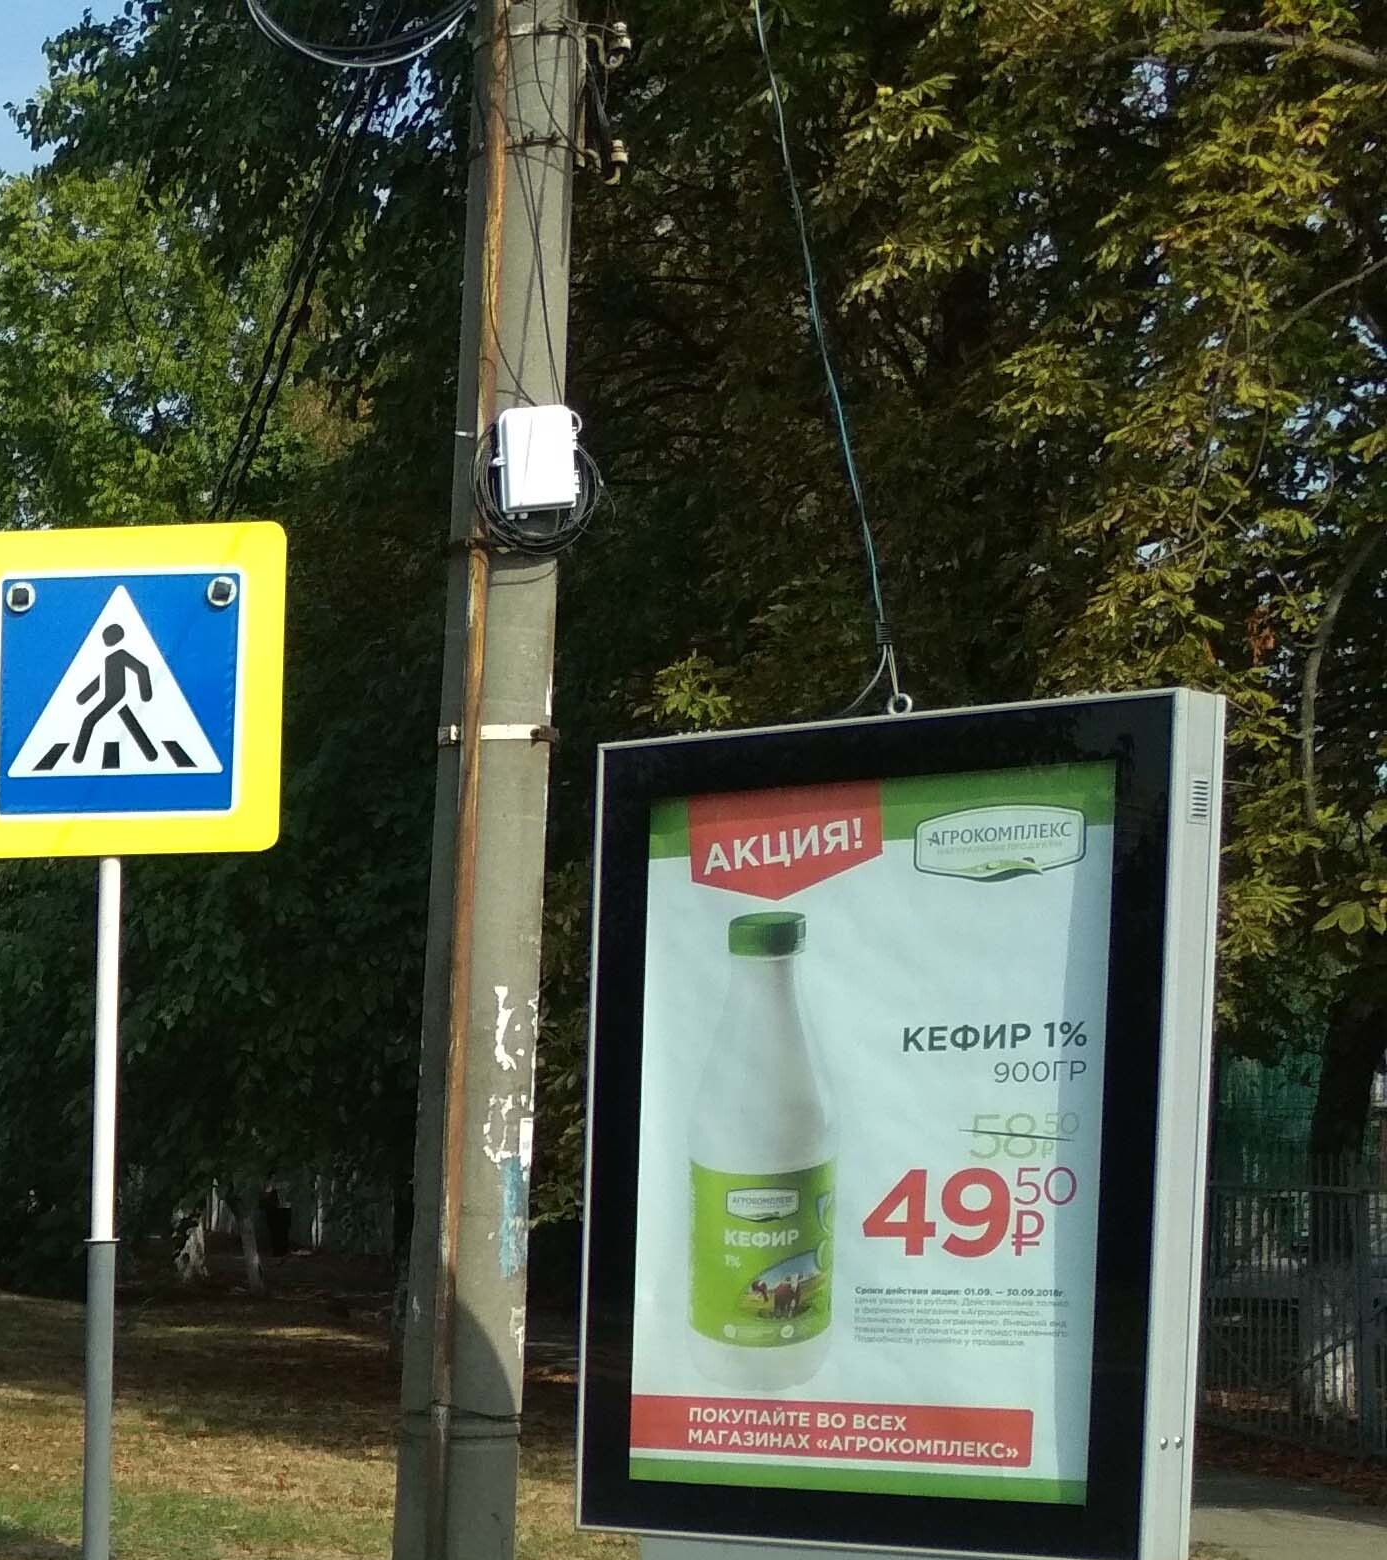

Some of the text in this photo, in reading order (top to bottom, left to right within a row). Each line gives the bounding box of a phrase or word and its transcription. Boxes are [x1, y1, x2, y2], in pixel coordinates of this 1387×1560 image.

[703, 816, 863, 876] АКЦИЯ!
[926, 821, 1073, 847] АГРОКОМПЛЕКС
[902, 1020, 1088, 1052] КЕФИР 1%
[993, 1060, 1088, 1084] 900ГР
[969, 1112, 1038, 1159] 58
[1043, 1112, 1080, 1136] 50
[862, 1167, 1012, 1258] 49
[1013, 1166, 1078, 1206] 50
[723, 1228, 799, 1248] КЕФИР
[688, 1405, 908, 1433] ПОКУПАЙТЕ ВО ВСЕХ
[688, 1428, 1019, 1460] МАГАЗИНАХ «АГРОКОМПЛЕКС»
